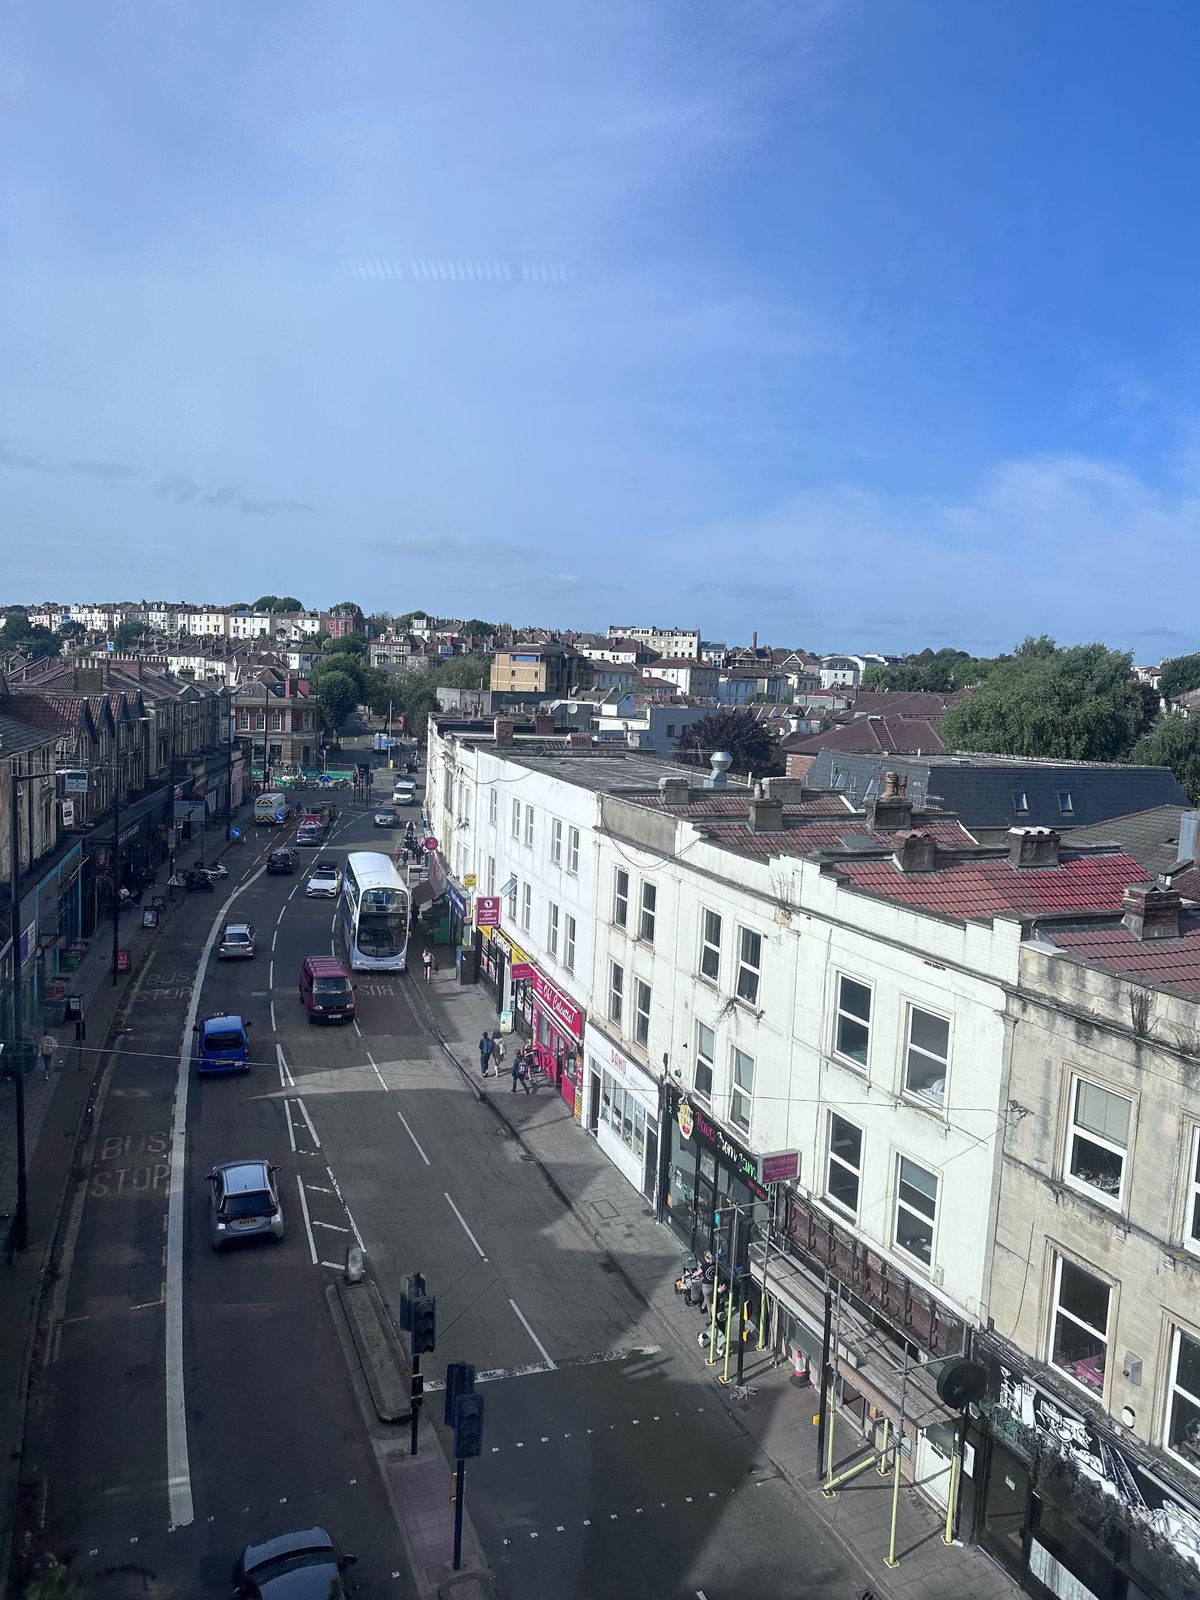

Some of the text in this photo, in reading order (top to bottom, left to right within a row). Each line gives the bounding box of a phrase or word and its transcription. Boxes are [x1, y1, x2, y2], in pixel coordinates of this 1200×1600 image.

[146, 972, 190, 986] BUS
[135, 986, 193, 1002] STOP
[358, 984, 395, 997] BUS
[101, 1131, 168, 1161] BUS
[90, 1164, 171, 1197] STOP
